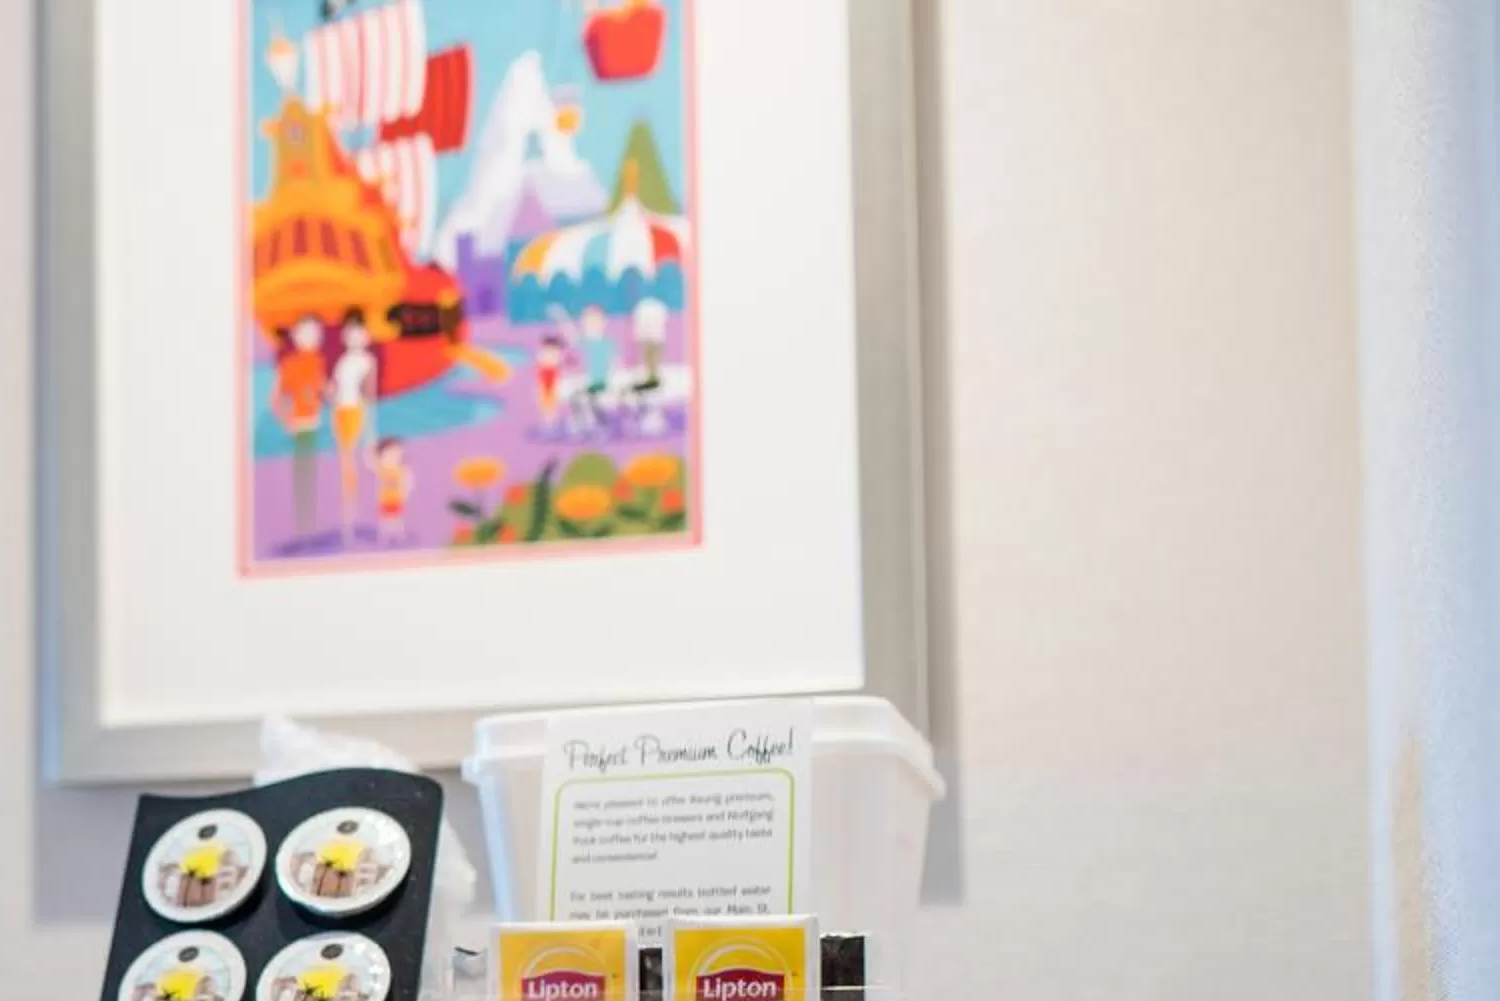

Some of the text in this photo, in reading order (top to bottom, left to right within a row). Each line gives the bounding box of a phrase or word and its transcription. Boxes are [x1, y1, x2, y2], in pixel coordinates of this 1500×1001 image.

[563, 727, 794, 774] Perfect Premium Coffee!
[527, 981, 598, 1001] Lipton
[703, 977, 777, 1001] Lipton
